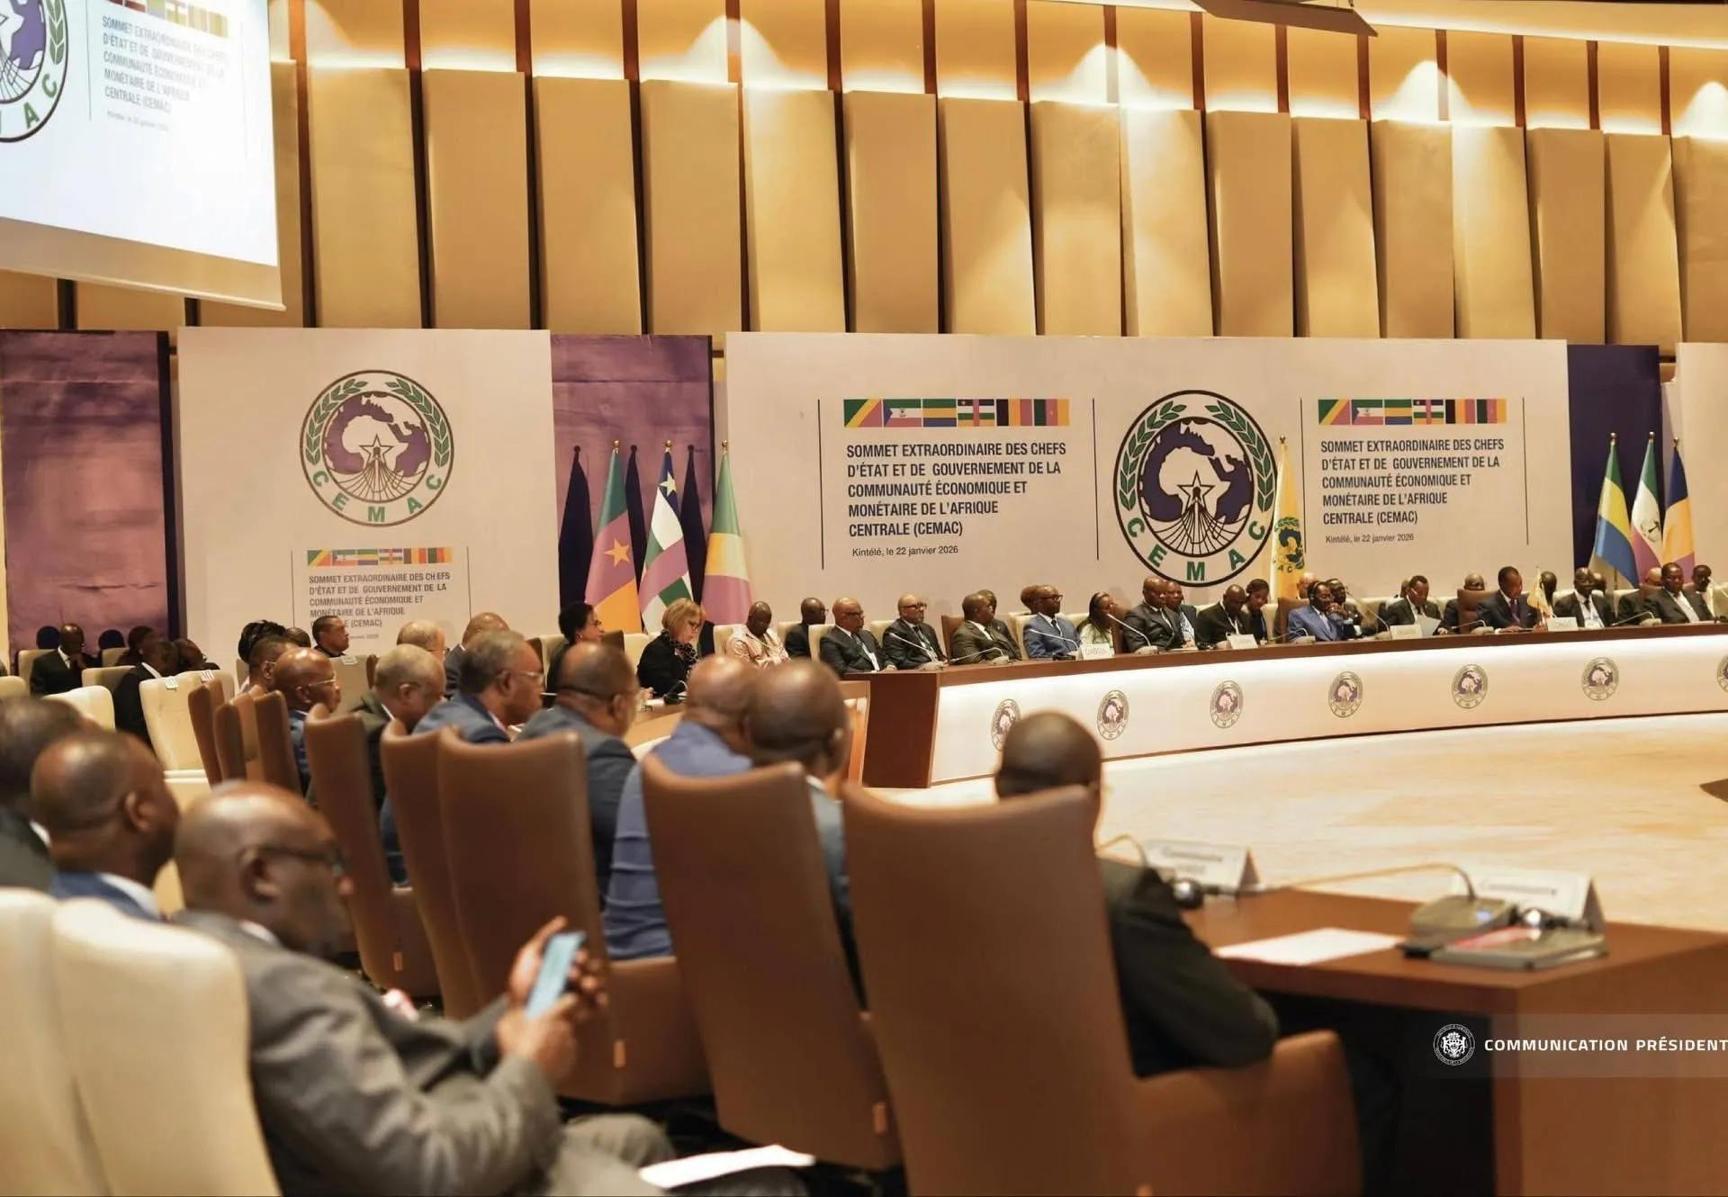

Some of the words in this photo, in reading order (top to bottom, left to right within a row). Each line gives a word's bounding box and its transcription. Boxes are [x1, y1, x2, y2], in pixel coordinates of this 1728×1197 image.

[847, 444, 898, 458] SOMMET
[902, 443, 1002, 457] EXTRAORDINAIRE
[1006, 443, 1027, 455] DES
[1031, 442, 1066, 455] CHEFS
[1321, 441, 1364, 452] SOMMET
[1367, 439, 1450, 452] EXTRAORDINAIRE
[1453, 439, 1471, 450] DES
[1474, 439, 1504, 450] CHEFS
[848, 463, 888, 477] D'ÉTAT
[893, 464, 906, 476] ET
[910, 464, 925, 476] DE
[933, 462, 1024, 476] GOUVERNEMENT
[1029, 462, 1043, 474] DE
[1046, 461, 1061, 473] LA
[1322, 457, 1355, 470] D'ÉTAT
[1359, 458, 1370, 470] ET
[1374, 458, 1387, 469] DE
[1393, 456, 1469, 469] GOUVERNEMENT
[1473, 456, 1484, 467] DE
[1488, 456, 1499, 467] LA
[1322, 475, 1392, 489] COMMUNAUTÉ
[1396, 473, 1457, 487] ÉCONOMIQUE
[1461, 474, 1471, 485] ET
[313, 470, 442, 522] CEMAC
[848, 481, 932, 498] COMMUNAUTÉ
[936, 480, 1011, 495] ÉCONOMIQUE
[1014, 481, 1027, 493] ET
[1323, 492, 1380, 506] MONÉTAIRE
[1383, 494, 1396, 505] DE
[1399, 492, 1447, 505] L'AFRIQUE
[849, 501, 917, 517] MONÉTAIRE
[921, 502, 936, 515] DE
[940, 500, 998, 515] L'AFRIQUE
[1323, 512, 1373, 525] CENTRALE
[1377, 511, 1417, 525] (CEMAC)
[849, 523, 909, 537] CENTRALE
[913, 521, 963, 537] (CEMAC)
[1354, 535, 1360, 543] le
[1362, 534, 1370, 542] 22
[1372, 534, 1395, 544] janvier
[1397, 534, 1414, 542] 2026
[852, 547, 884, 557] Kintélé,
[886, 547, 894, 556] le
[896, 546, 906, 555] 22
[908, 546, 936, 556] janvier
[938, 545, 958, 554] 2026
[1127, 517, 1265, 581] CEMAC
[309, 575, 341, 583] SOMMET
[344, 573, 407, 583] EXTRAORDINAIRE
[309, 586, 335, 595] D'ÉTAT
[338, 586, 346, 594] ET
[349, 586, 358, 594] DE
[363, 585, 422, 593] GOUVERNEMENT
[424, 584, 434, 592] DE
[310, 596, 361, 606] COMMUNAUTÉ
[365, 595, 413, 605] ÉCONOMIQUE
[415, 595, 424, 603] ET
[355, 608, 365, 616] DE
[367, 607, 404, 615] L'AFRIQUE
[351, 619, 382, 628] (CEMAC)
